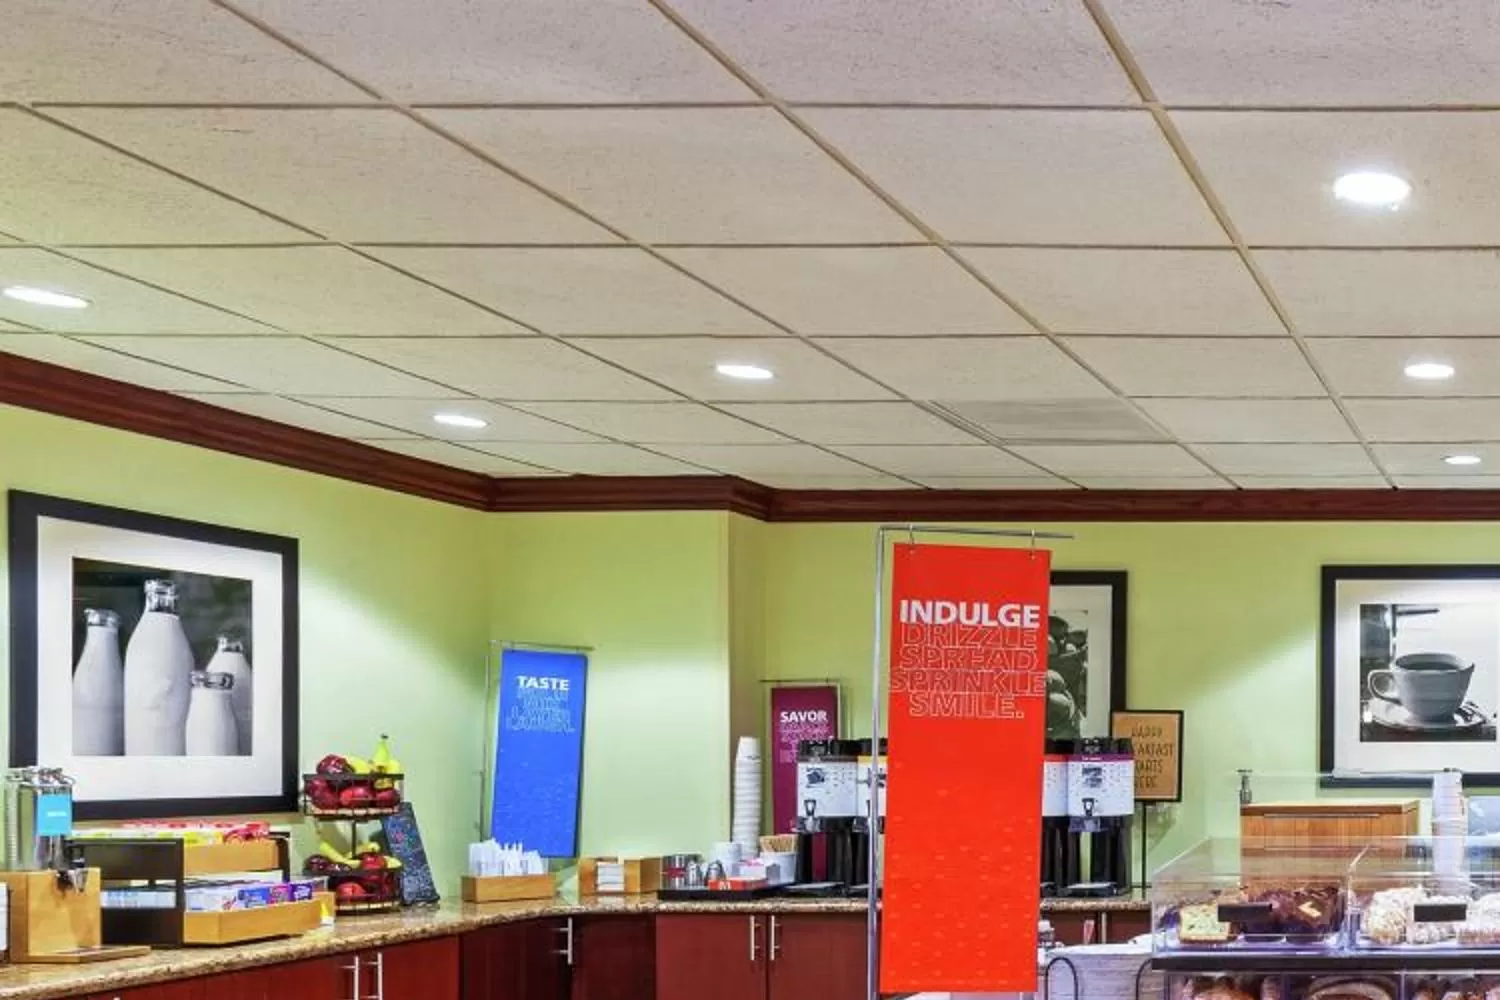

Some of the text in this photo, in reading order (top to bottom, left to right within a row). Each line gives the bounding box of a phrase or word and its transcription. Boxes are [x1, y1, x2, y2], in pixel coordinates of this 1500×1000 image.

[900, 599, 1041, 629] INDULGE
[901, 623, 1038, 651] DRIZZLE
[900, 645, 1038, 673] SPREAD
[516, 675, 570, 691] TASTE
[889, 667, 1047, 697] SPRINKLE
[780, 710, 828, 723] SAVOR
[909, 692, 1025, 719] SMILE.
